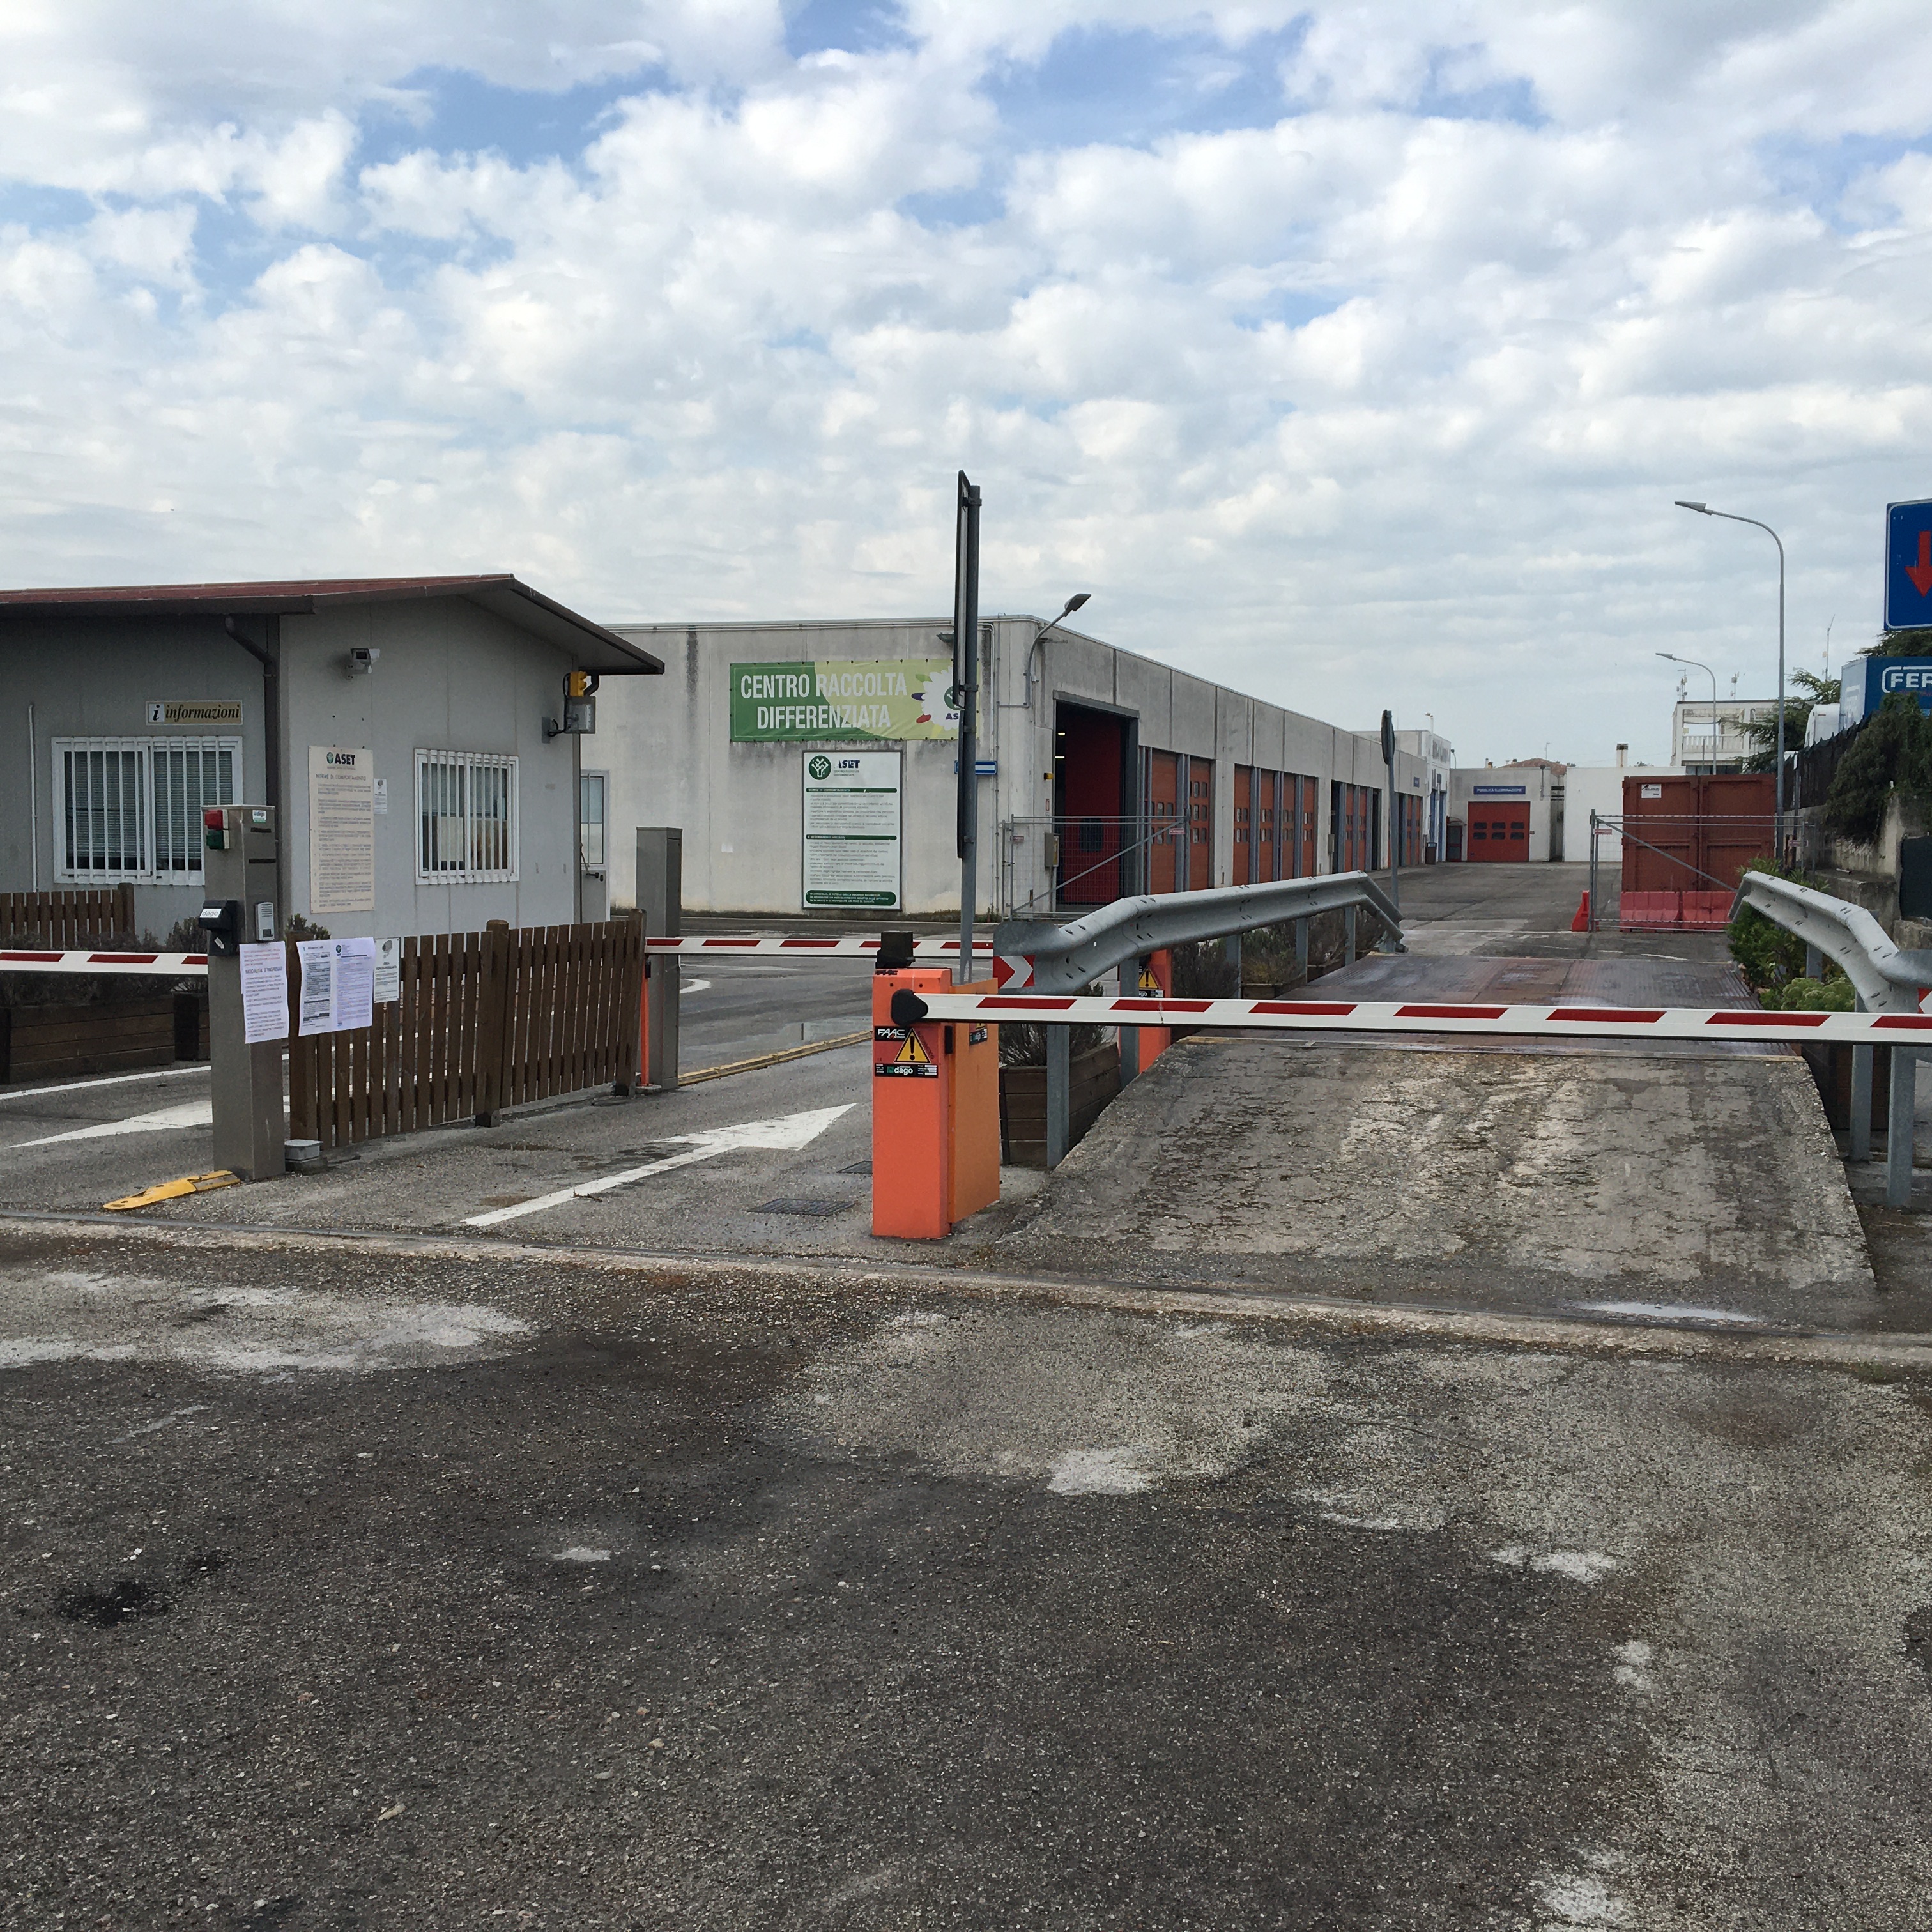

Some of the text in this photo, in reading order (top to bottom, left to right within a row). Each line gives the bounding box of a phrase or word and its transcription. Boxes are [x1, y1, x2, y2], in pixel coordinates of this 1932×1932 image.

[740, 673, 908, 698] CENTRO RACCOLTA
[165, 704, 240, 722] informazioni
[756, 704, 891, 730] DIFFERENZIATA
[334, 753, 356, 765] ASET
[201, 908, 219, 918] dago
[877, 1028, 906, 1038] FAAC
[894, 1066, 914, 1076] dago
